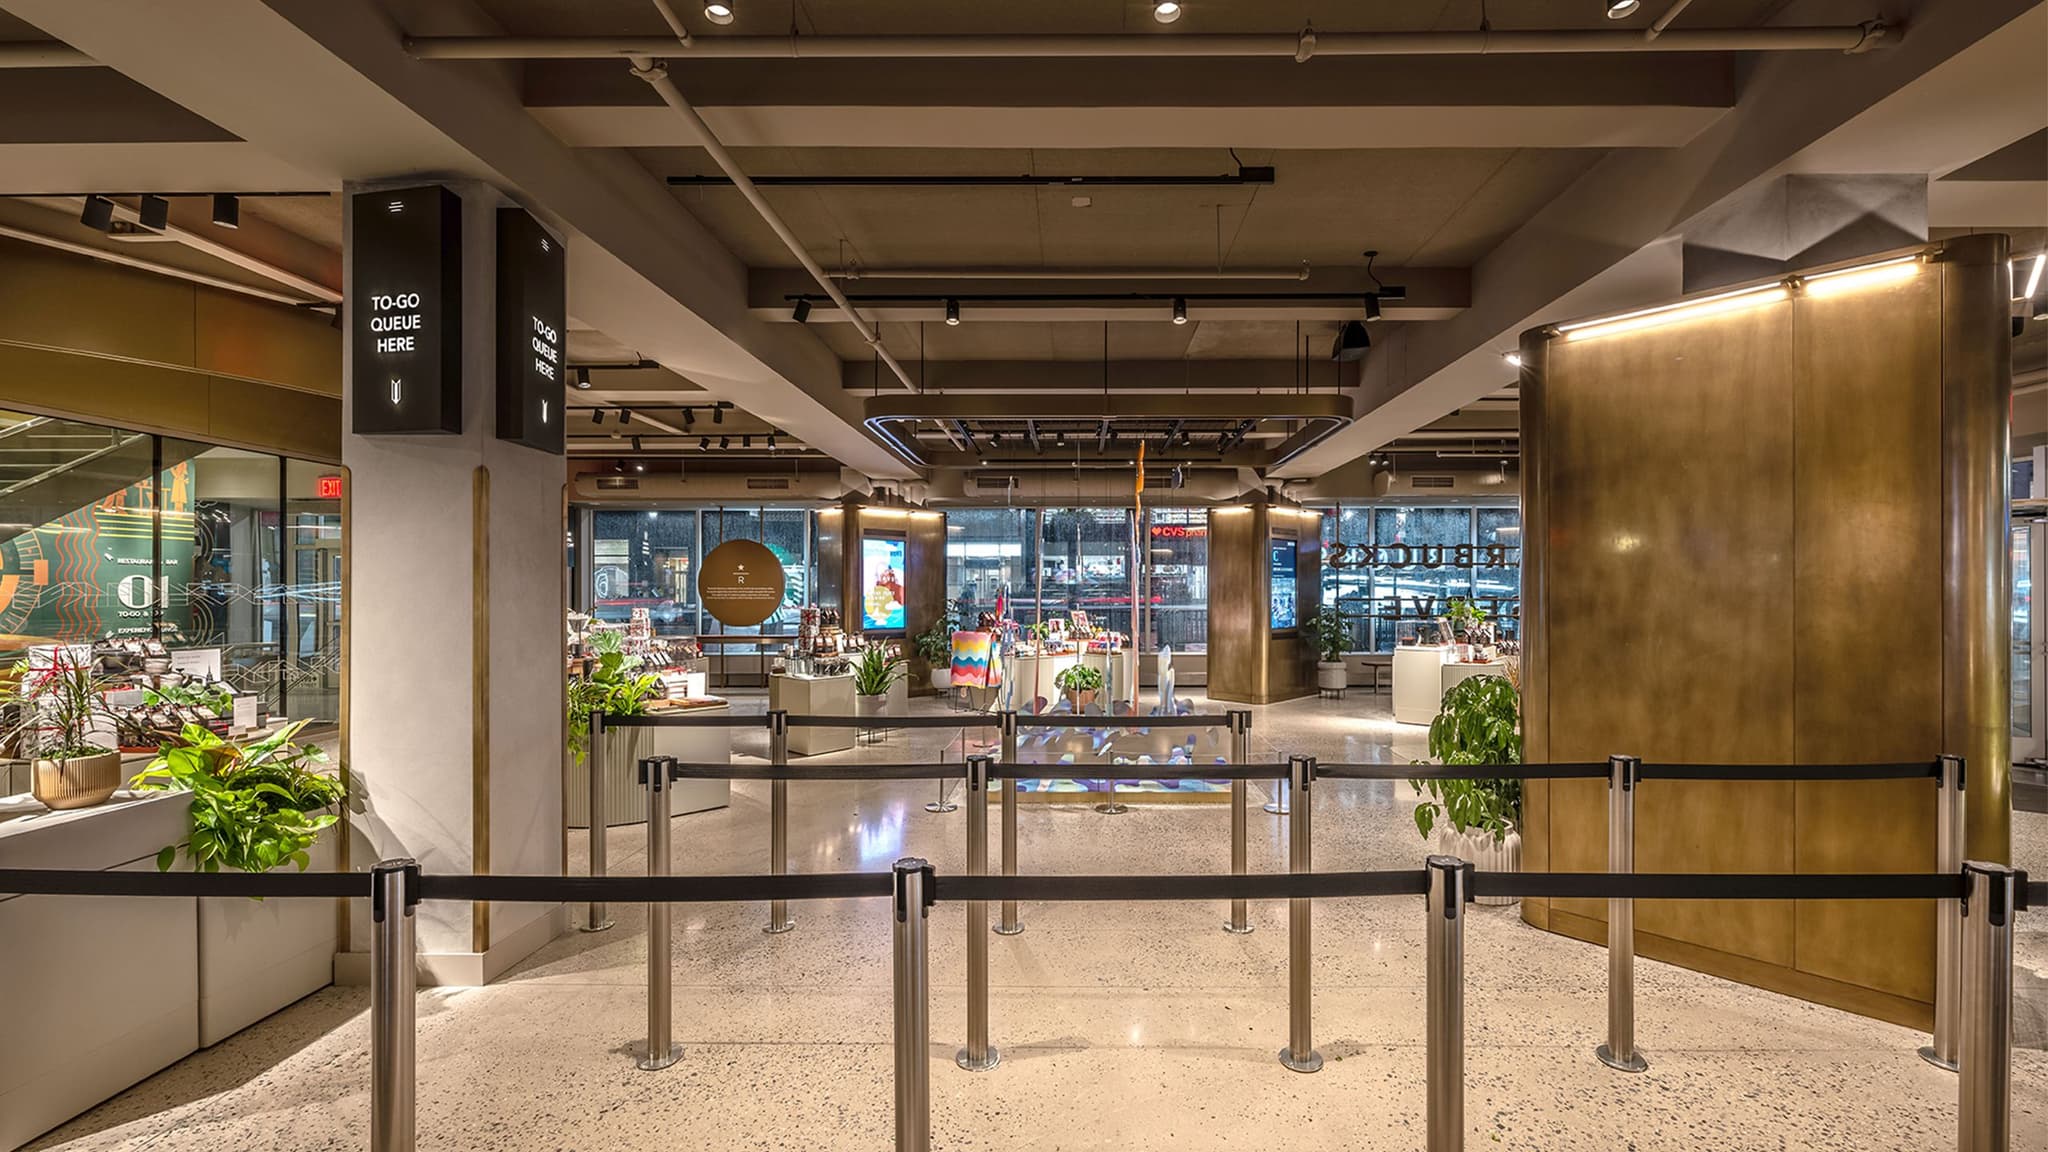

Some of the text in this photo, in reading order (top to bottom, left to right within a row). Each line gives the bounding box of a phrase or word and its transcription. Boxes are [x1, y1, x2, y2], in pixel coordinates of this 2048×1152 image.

[371, 293, 420, 311] TO-GO
[371, 315, 421, 332] QUEUE
[532, 316, 557, 344] TO-GO
[377, 336, 415, 353] HERE
[532, 337, 558, 364] QUEUE
[535, 358, 555, 380] HERE
[322, 480, 341, 496] EXIT
[1162, 526, 1185, 537] CVS
[737, 575, 745, 584] R
